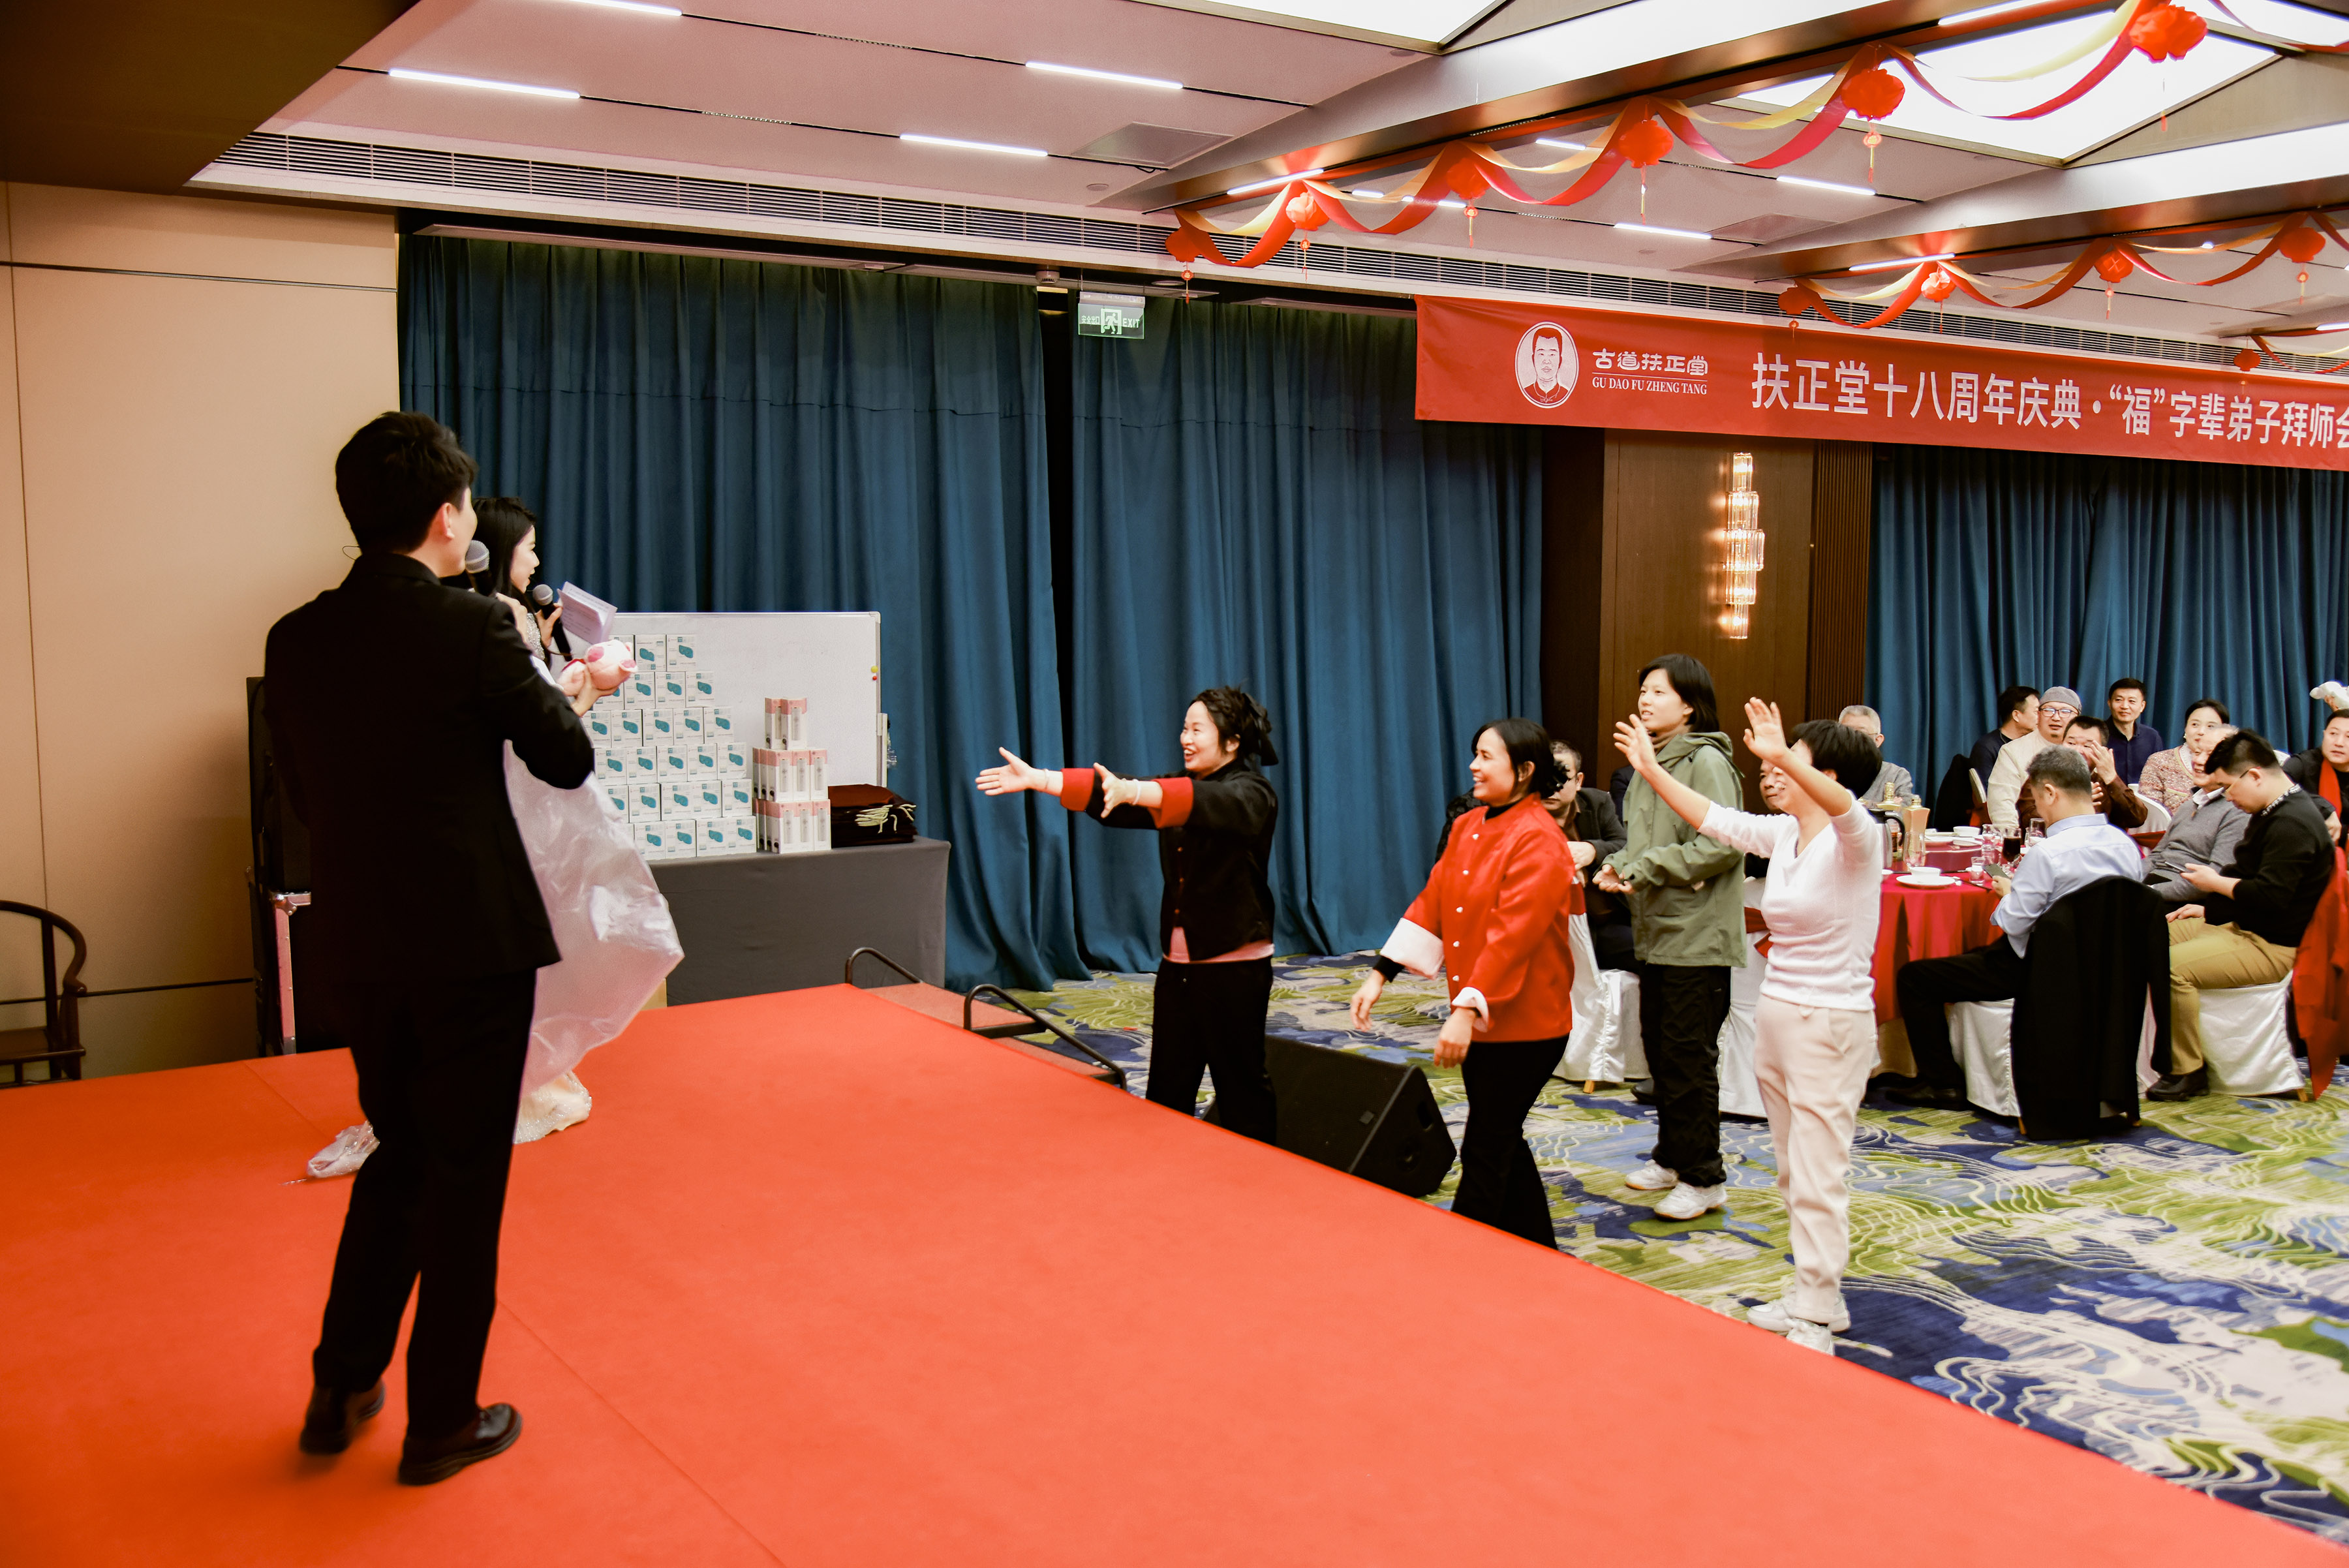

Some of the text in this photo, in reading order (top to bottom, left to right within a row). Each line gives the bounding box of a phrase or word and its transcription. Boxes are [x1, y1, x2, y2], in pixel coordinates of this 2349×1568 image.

[1081, 315, 1100, 325] 安全出口
[1123, 318, 1140, 328] EXIT
[1592, 348, 1708, 376] 古道扶正堂
[1592, 377, 1708, 395] GU DAO FU ZHENG TANG
